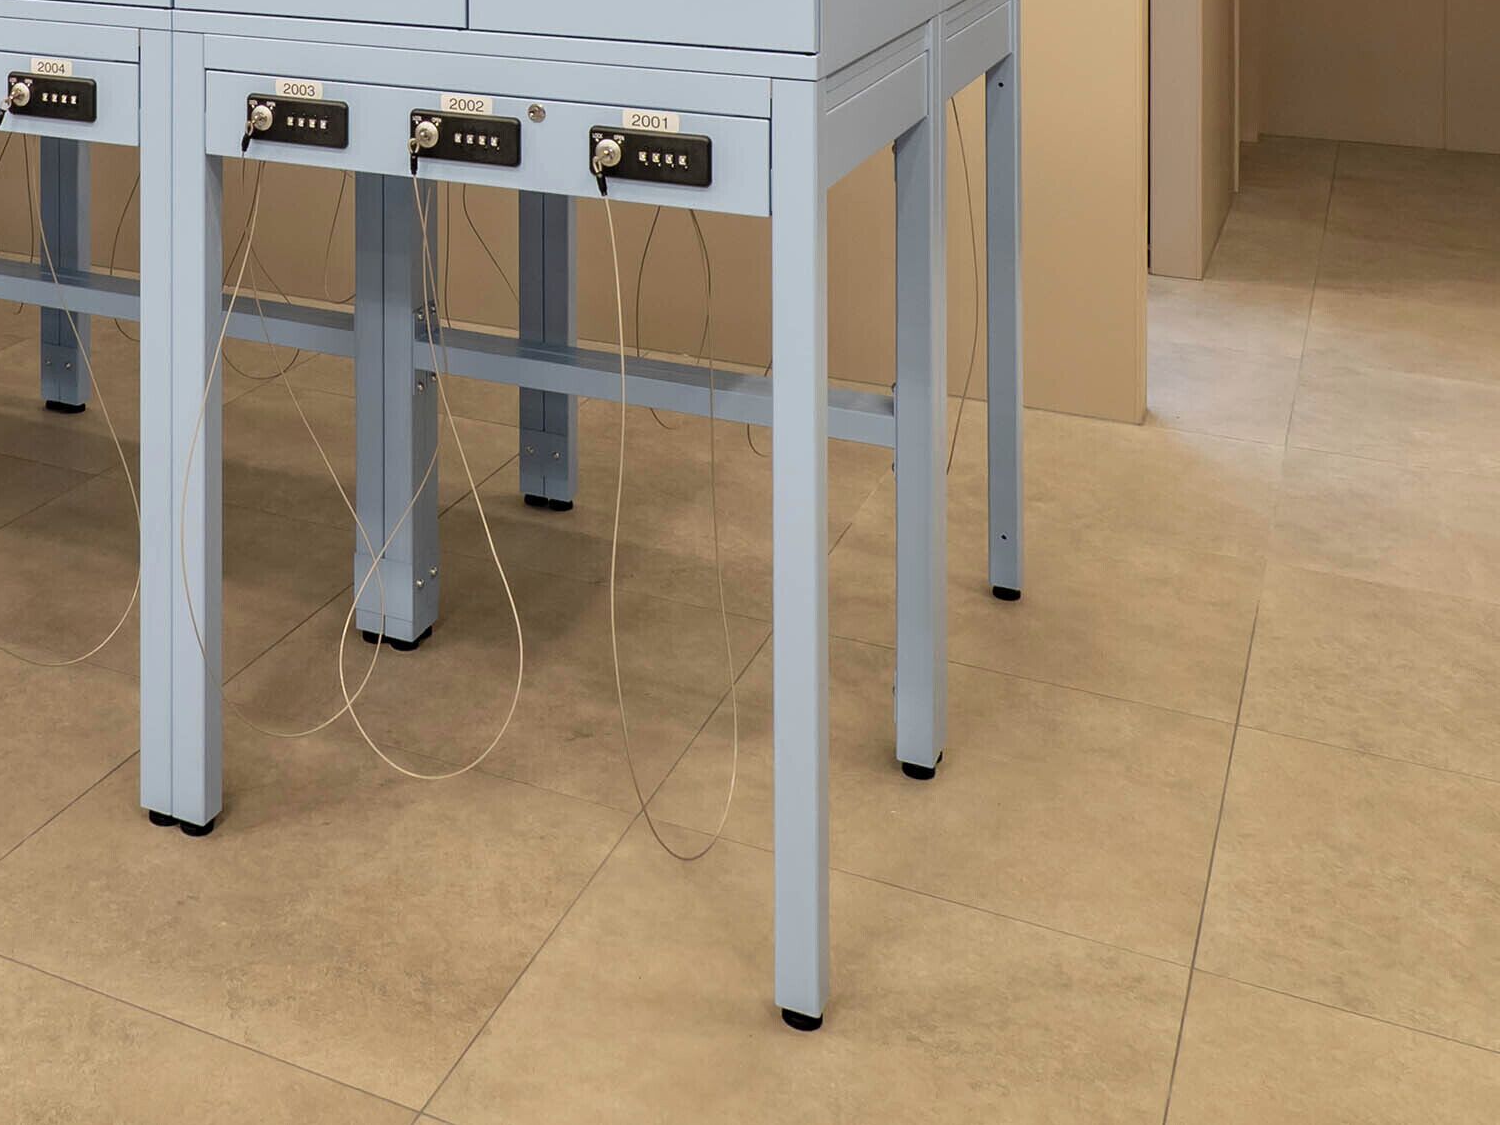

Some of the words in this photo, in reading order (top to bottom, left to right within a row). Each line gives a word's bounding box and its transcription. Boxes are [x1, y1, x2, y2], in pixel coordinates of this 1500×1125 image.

[37, 61, 66, 74] 2004
[283, 82, 315, 97] 2003
[449, 98, 484, 112] 2002
[631, 113, 669, 129] 2001
